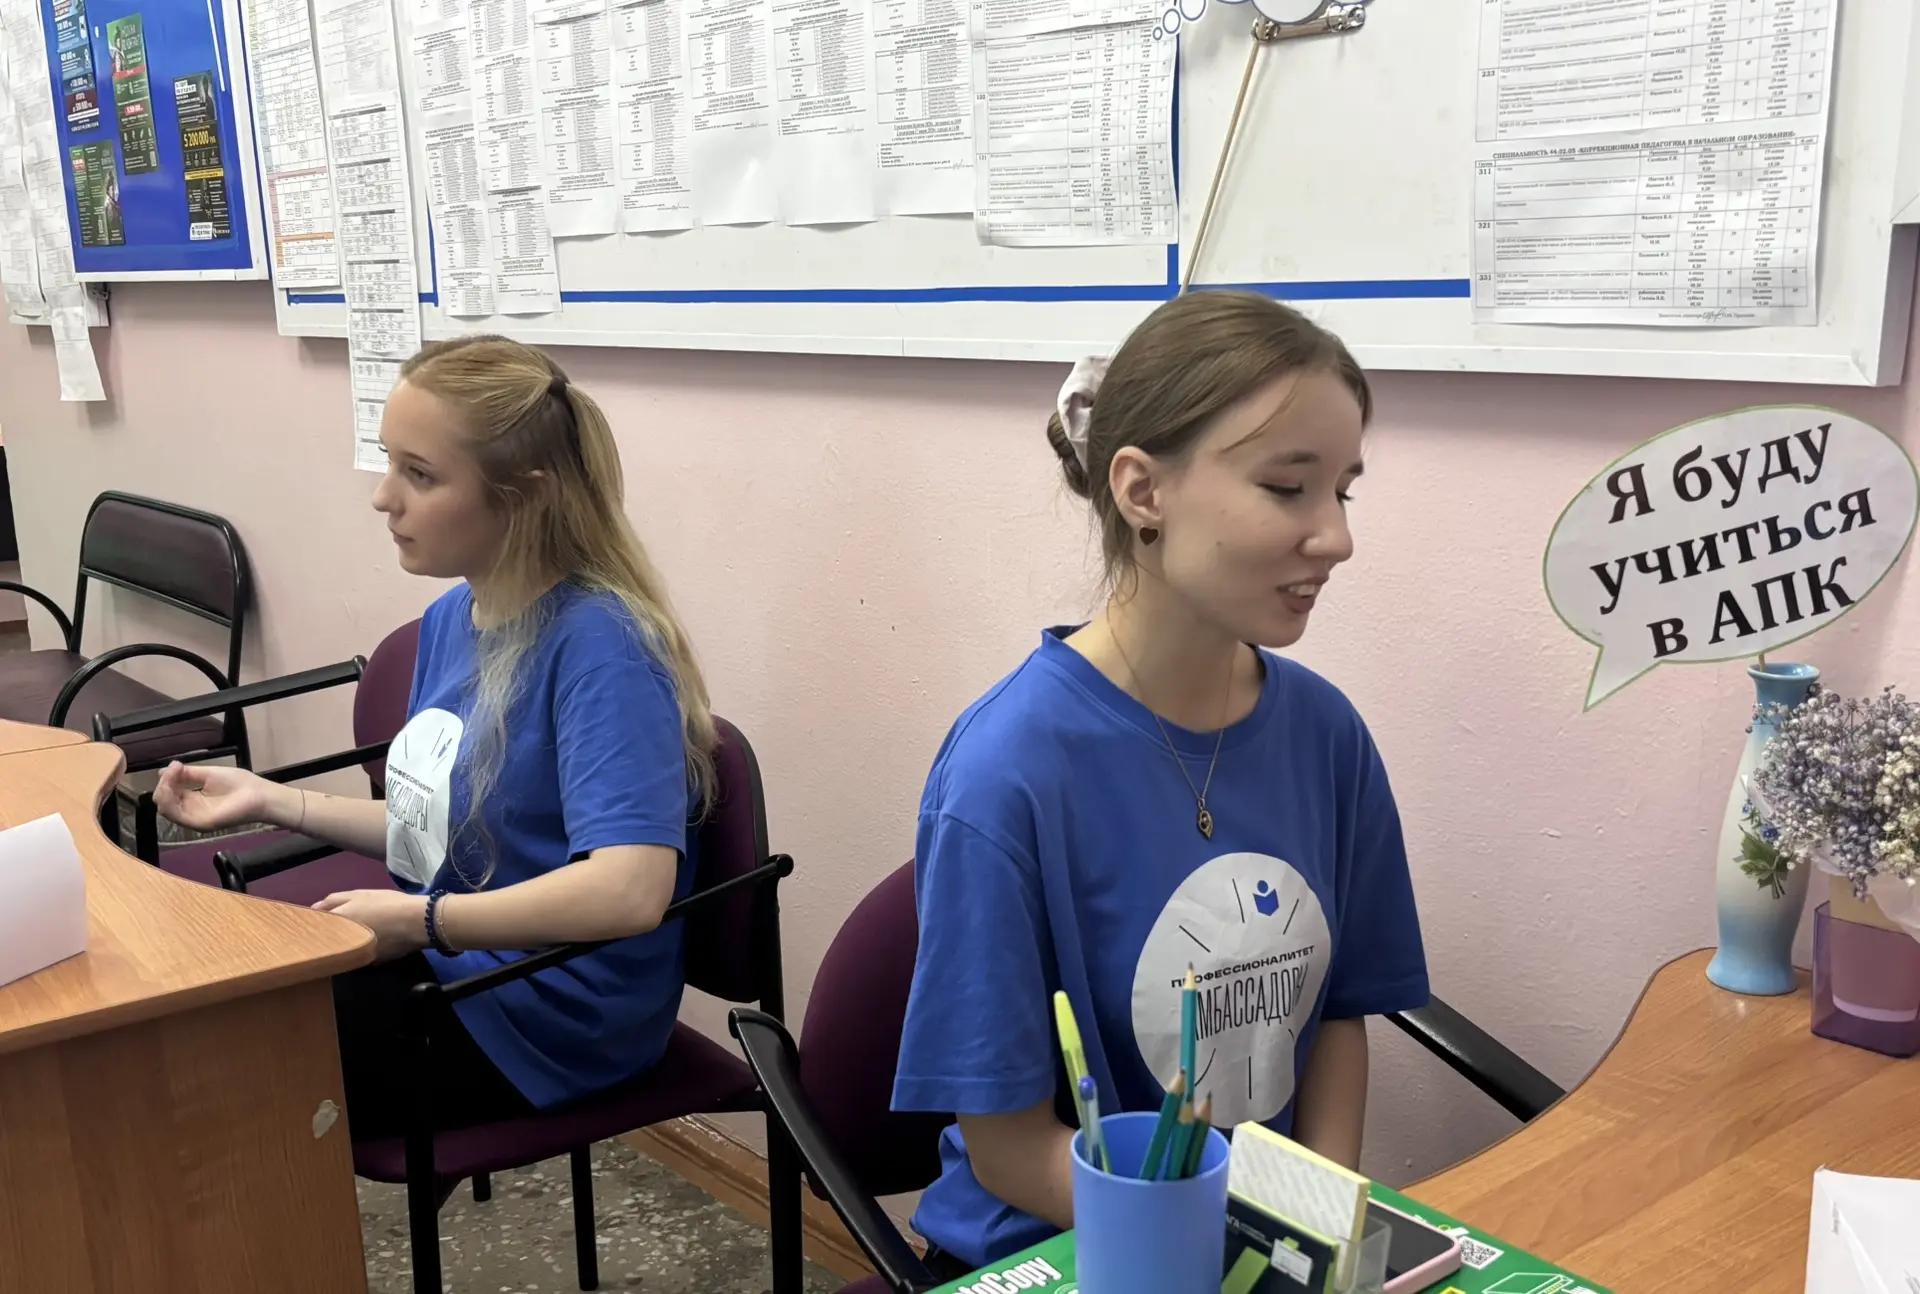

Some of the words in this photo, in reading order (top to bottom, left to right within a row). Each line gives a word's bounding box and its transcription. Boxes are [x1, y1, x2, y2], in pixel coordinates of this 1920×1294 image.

[1606, 463, 1656, 524] Я
[1672, 422, 1833, 509] буду
[1589, 486, 1878, 616] учиться
[1646, 615, 1689, 659] в
[1707, 555, 1856, 646] АПК
[1171, 945, 1315, 988] ПОФЕССИОНАЛИТЕТ
[1195, 962, 1309, 1041] МБАССАДОР
